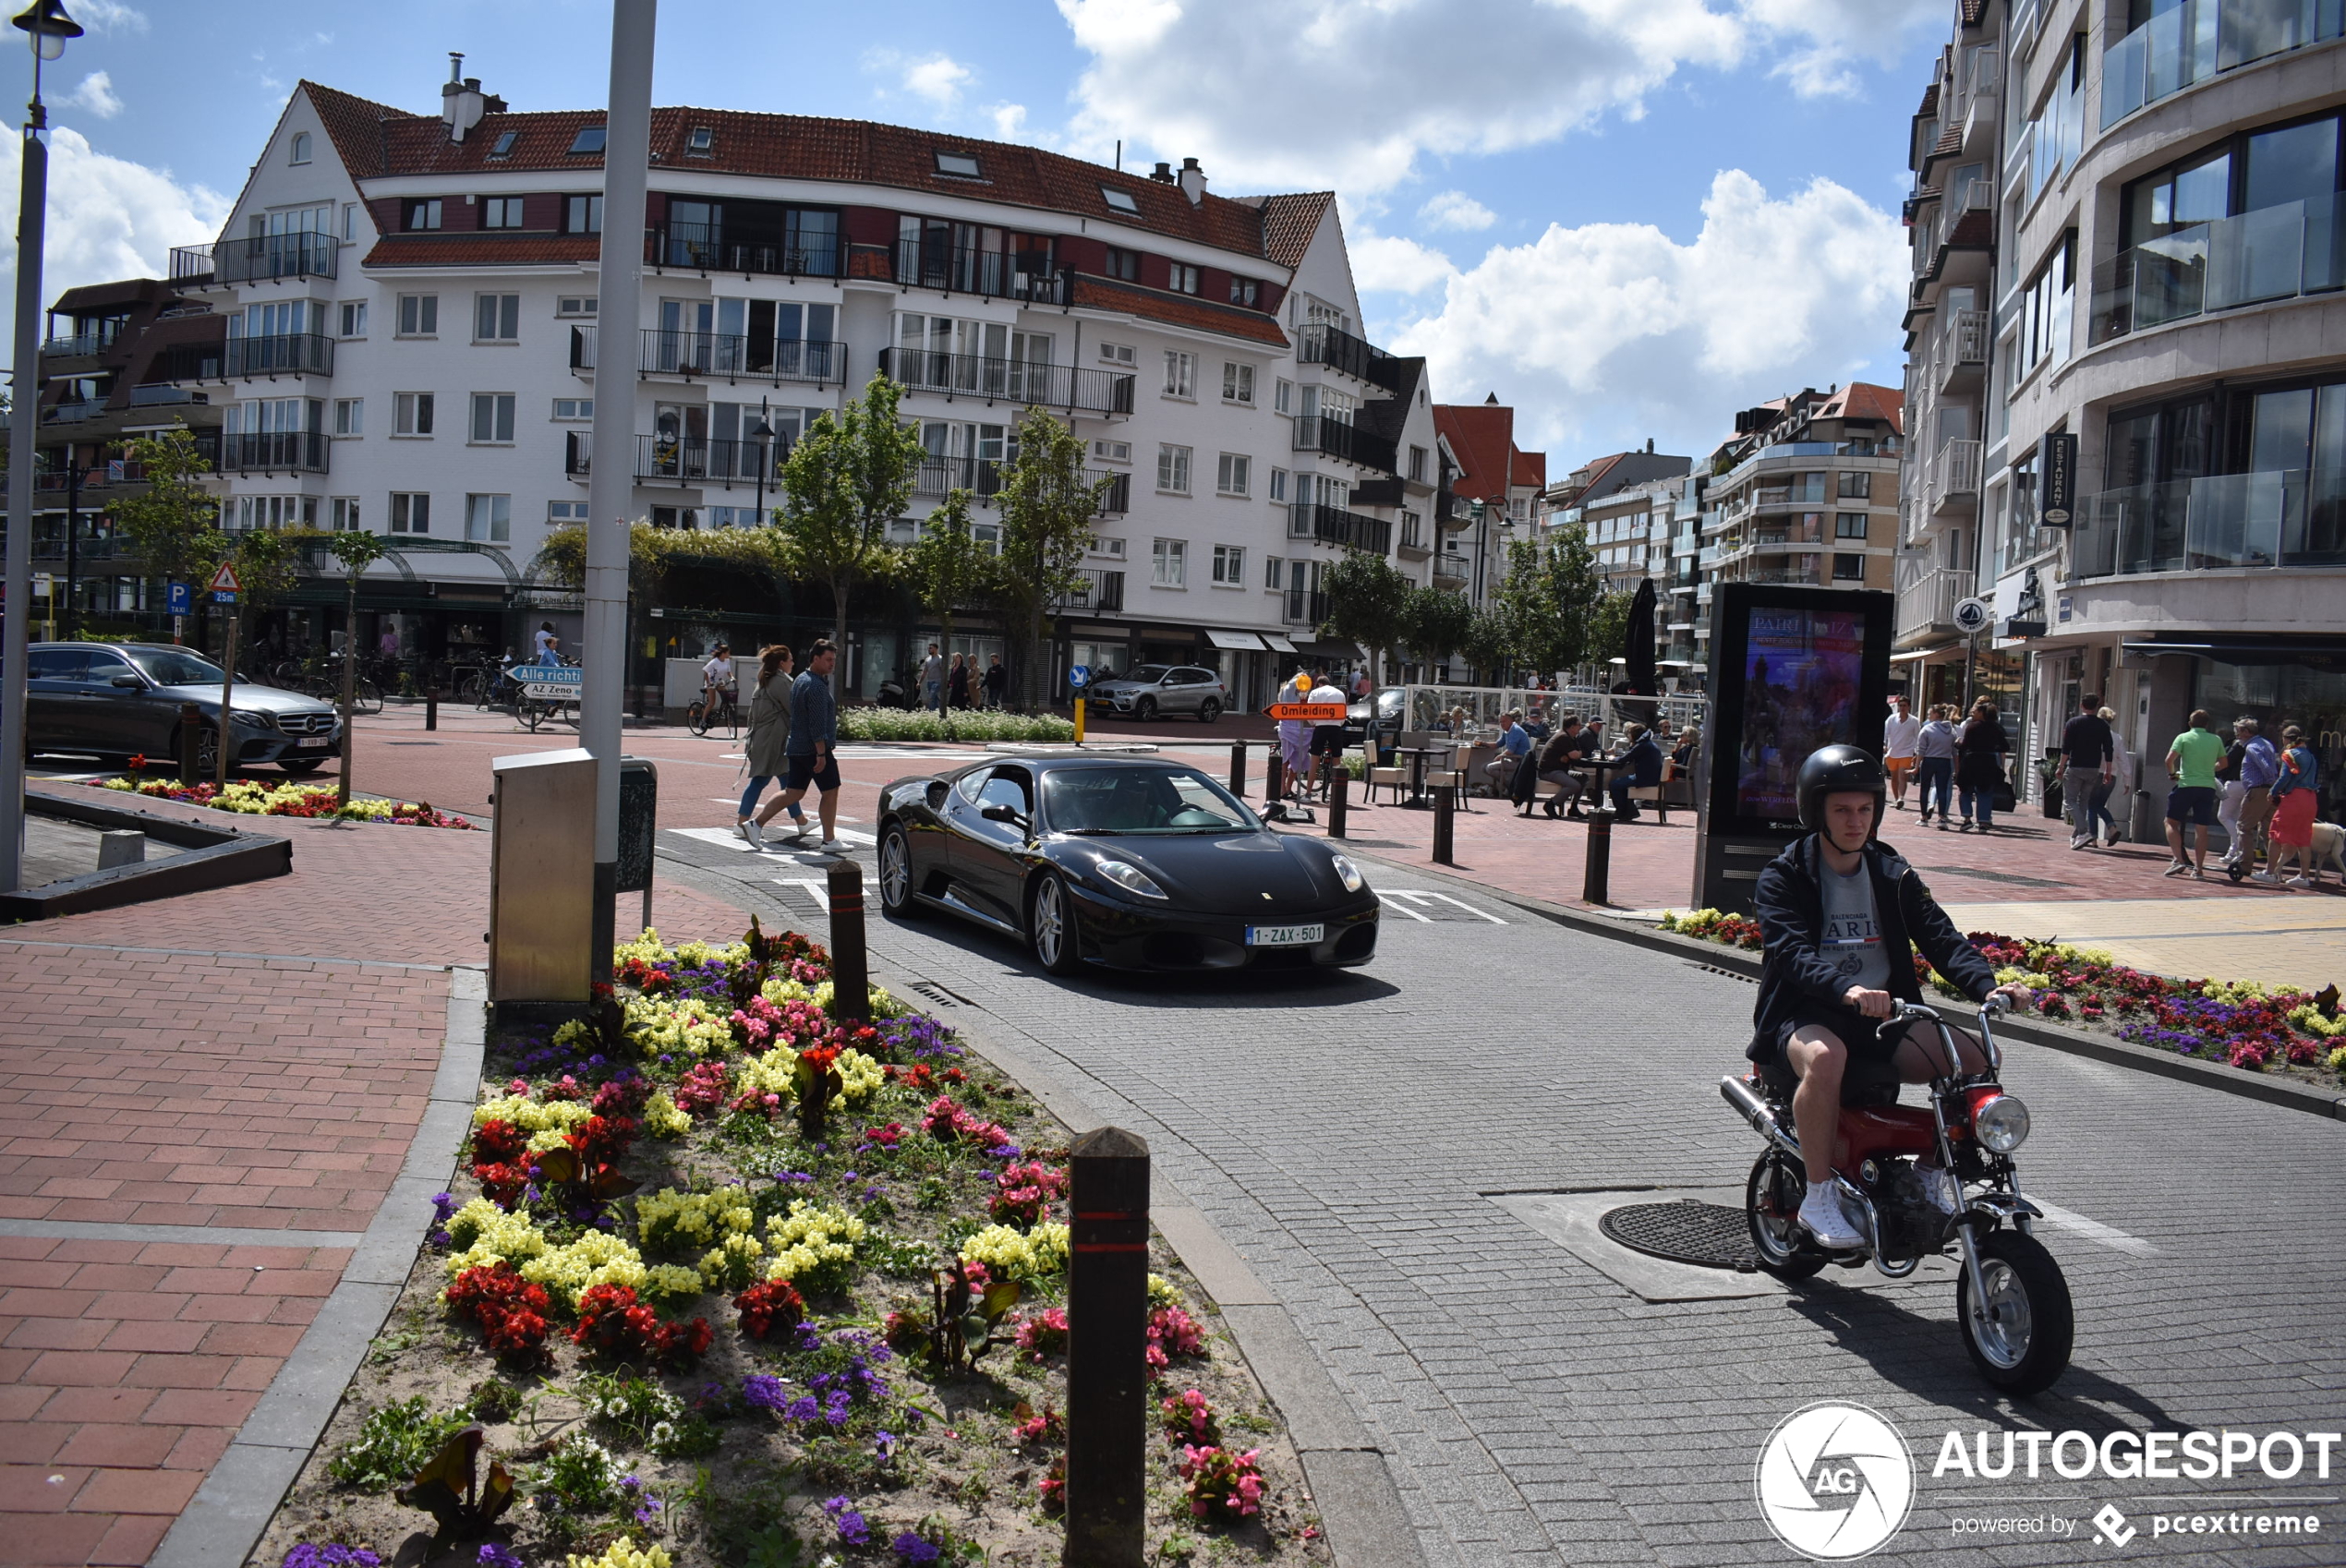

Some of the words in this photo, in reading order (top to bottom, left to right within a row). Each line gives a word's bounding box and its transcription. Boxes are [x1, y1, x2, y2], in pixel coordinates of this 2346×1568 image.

[2053, 440, 2064, 506] RESTAURANT
[172, 585, 185, 602] P
[216, 592, 234, 602] 25m
[1755, 617, 1799, 632] PAIRI
[520, 668, 544, 680] Alle
[532, 684, 545, 693] AZ
[549, 685, 572, 694] Zeno
[1281, 706, 1336, 718] Omleiding
[1831, 912, 1868, 921] BALENCIAGA
